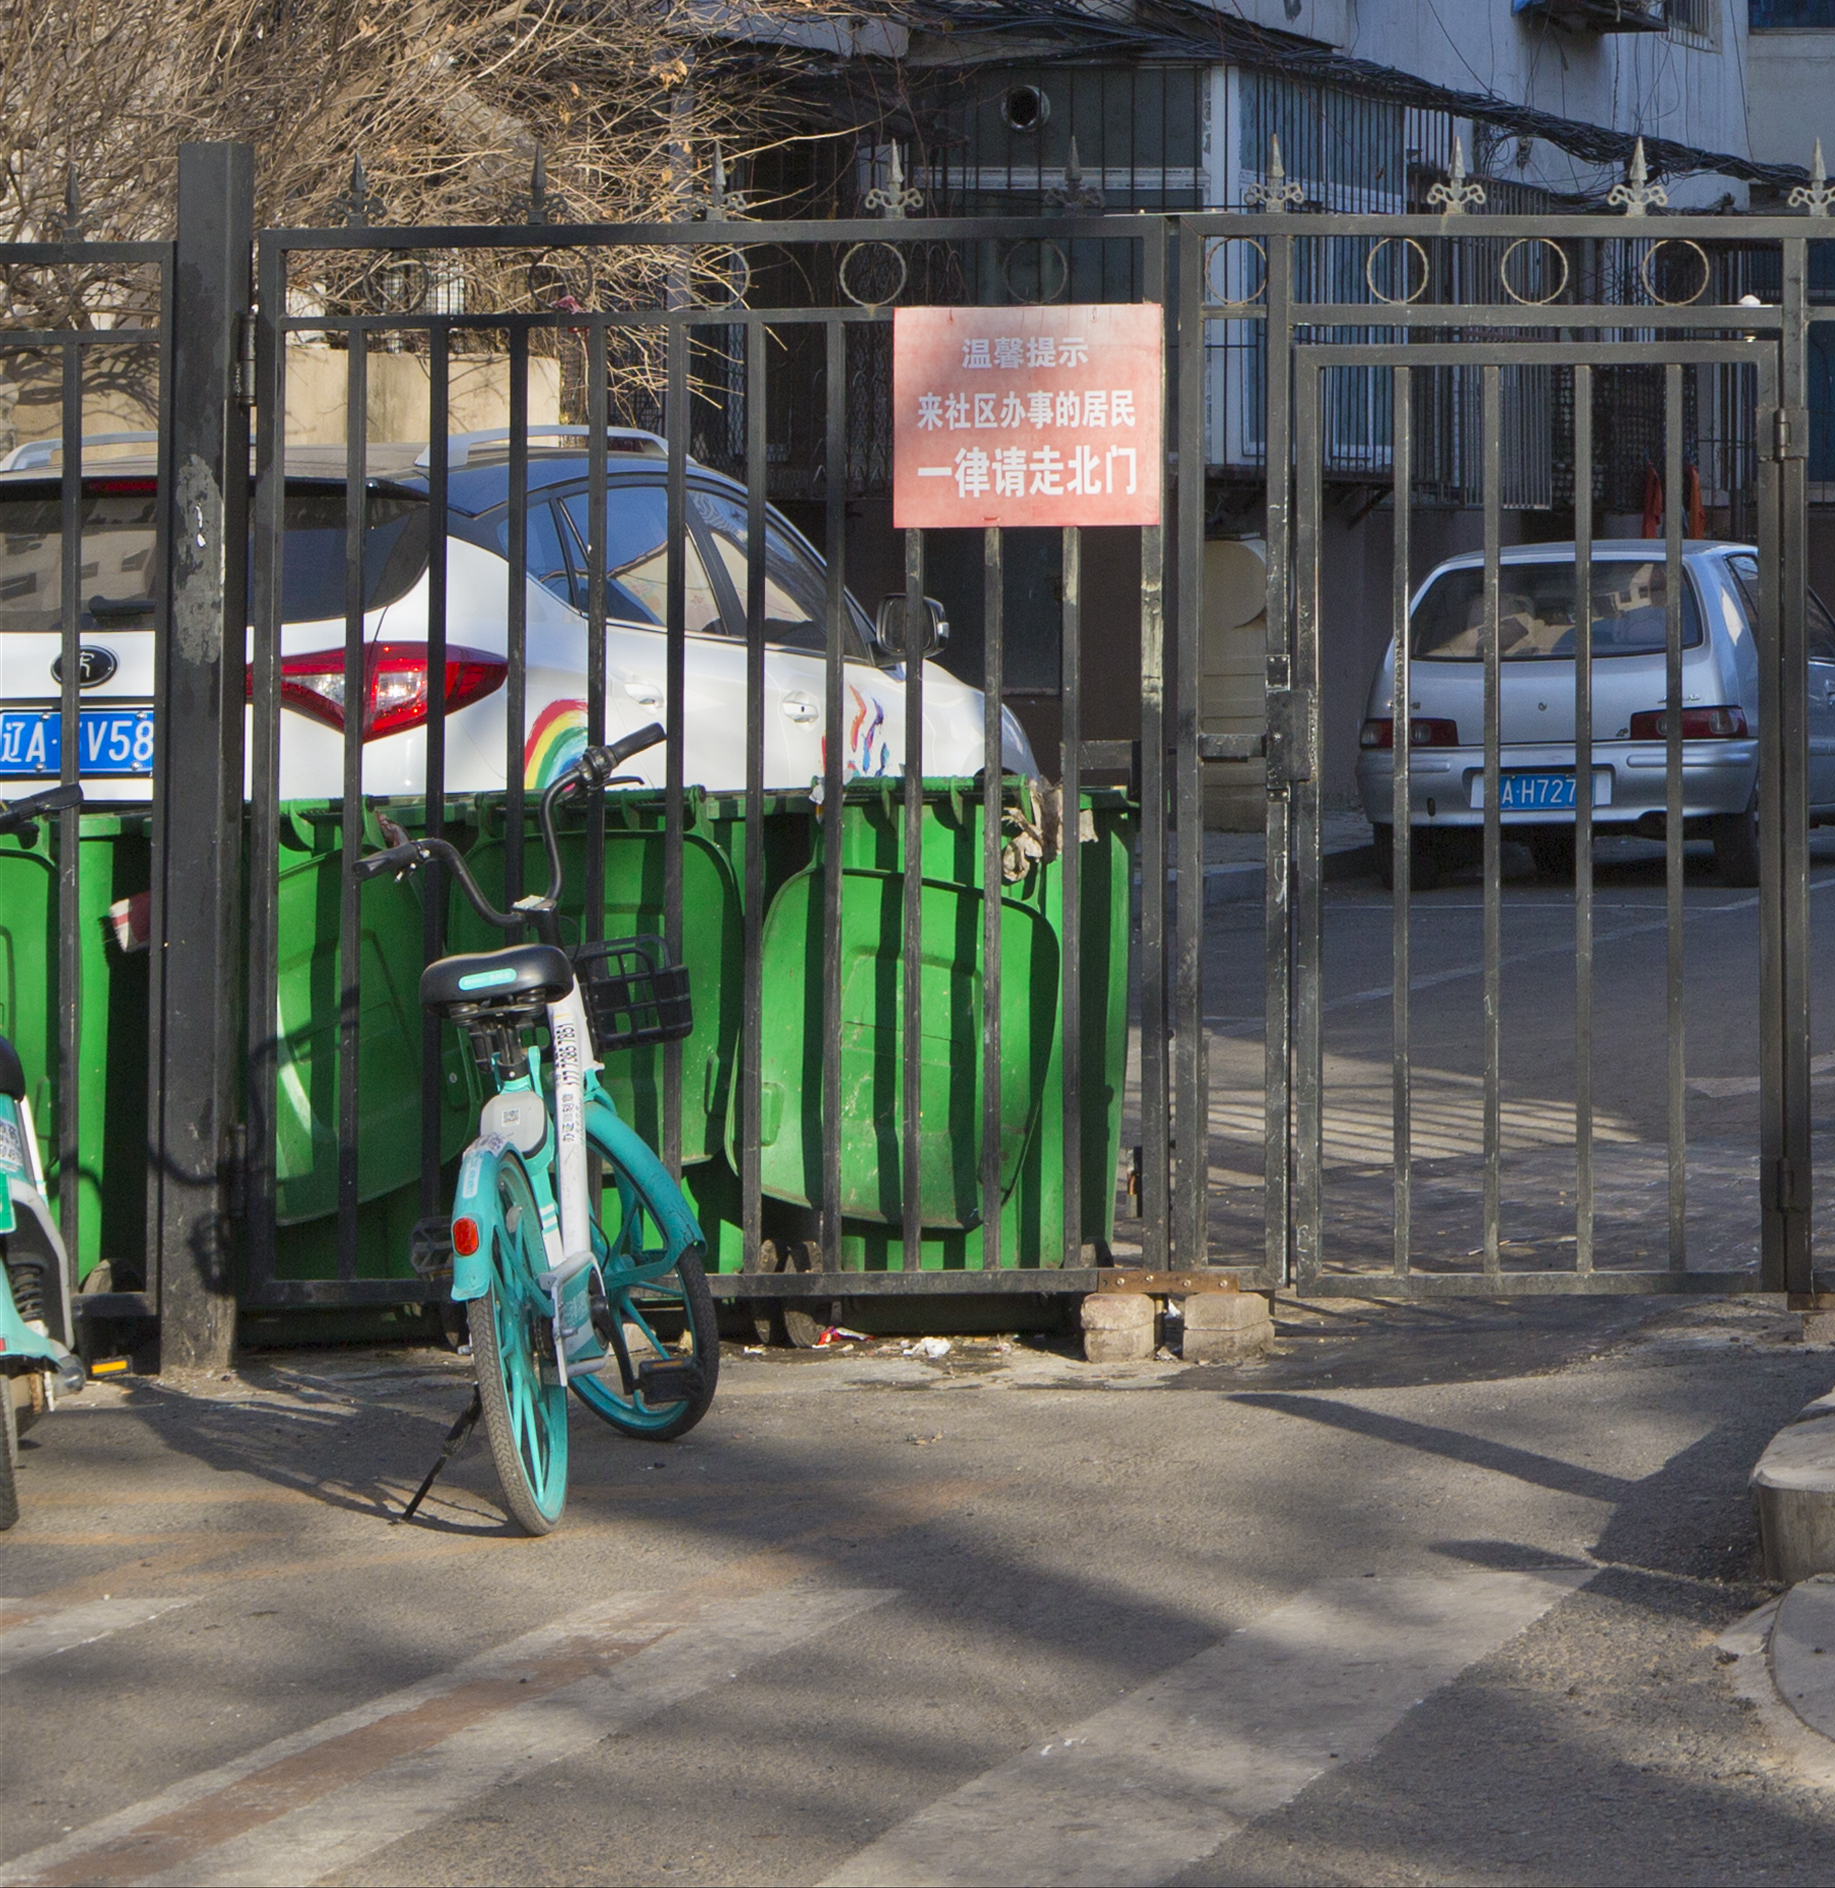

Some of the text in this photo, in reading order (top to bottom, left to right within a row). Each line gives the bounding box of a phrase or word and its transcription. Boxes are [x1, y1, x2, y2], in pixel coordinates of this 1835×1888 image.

[962, 337, 1089, 369] 温馨提示
[917, 390, 1136, 431] 来社区办事的居民
[917, 445, 1137, 498] 一律请走北门
